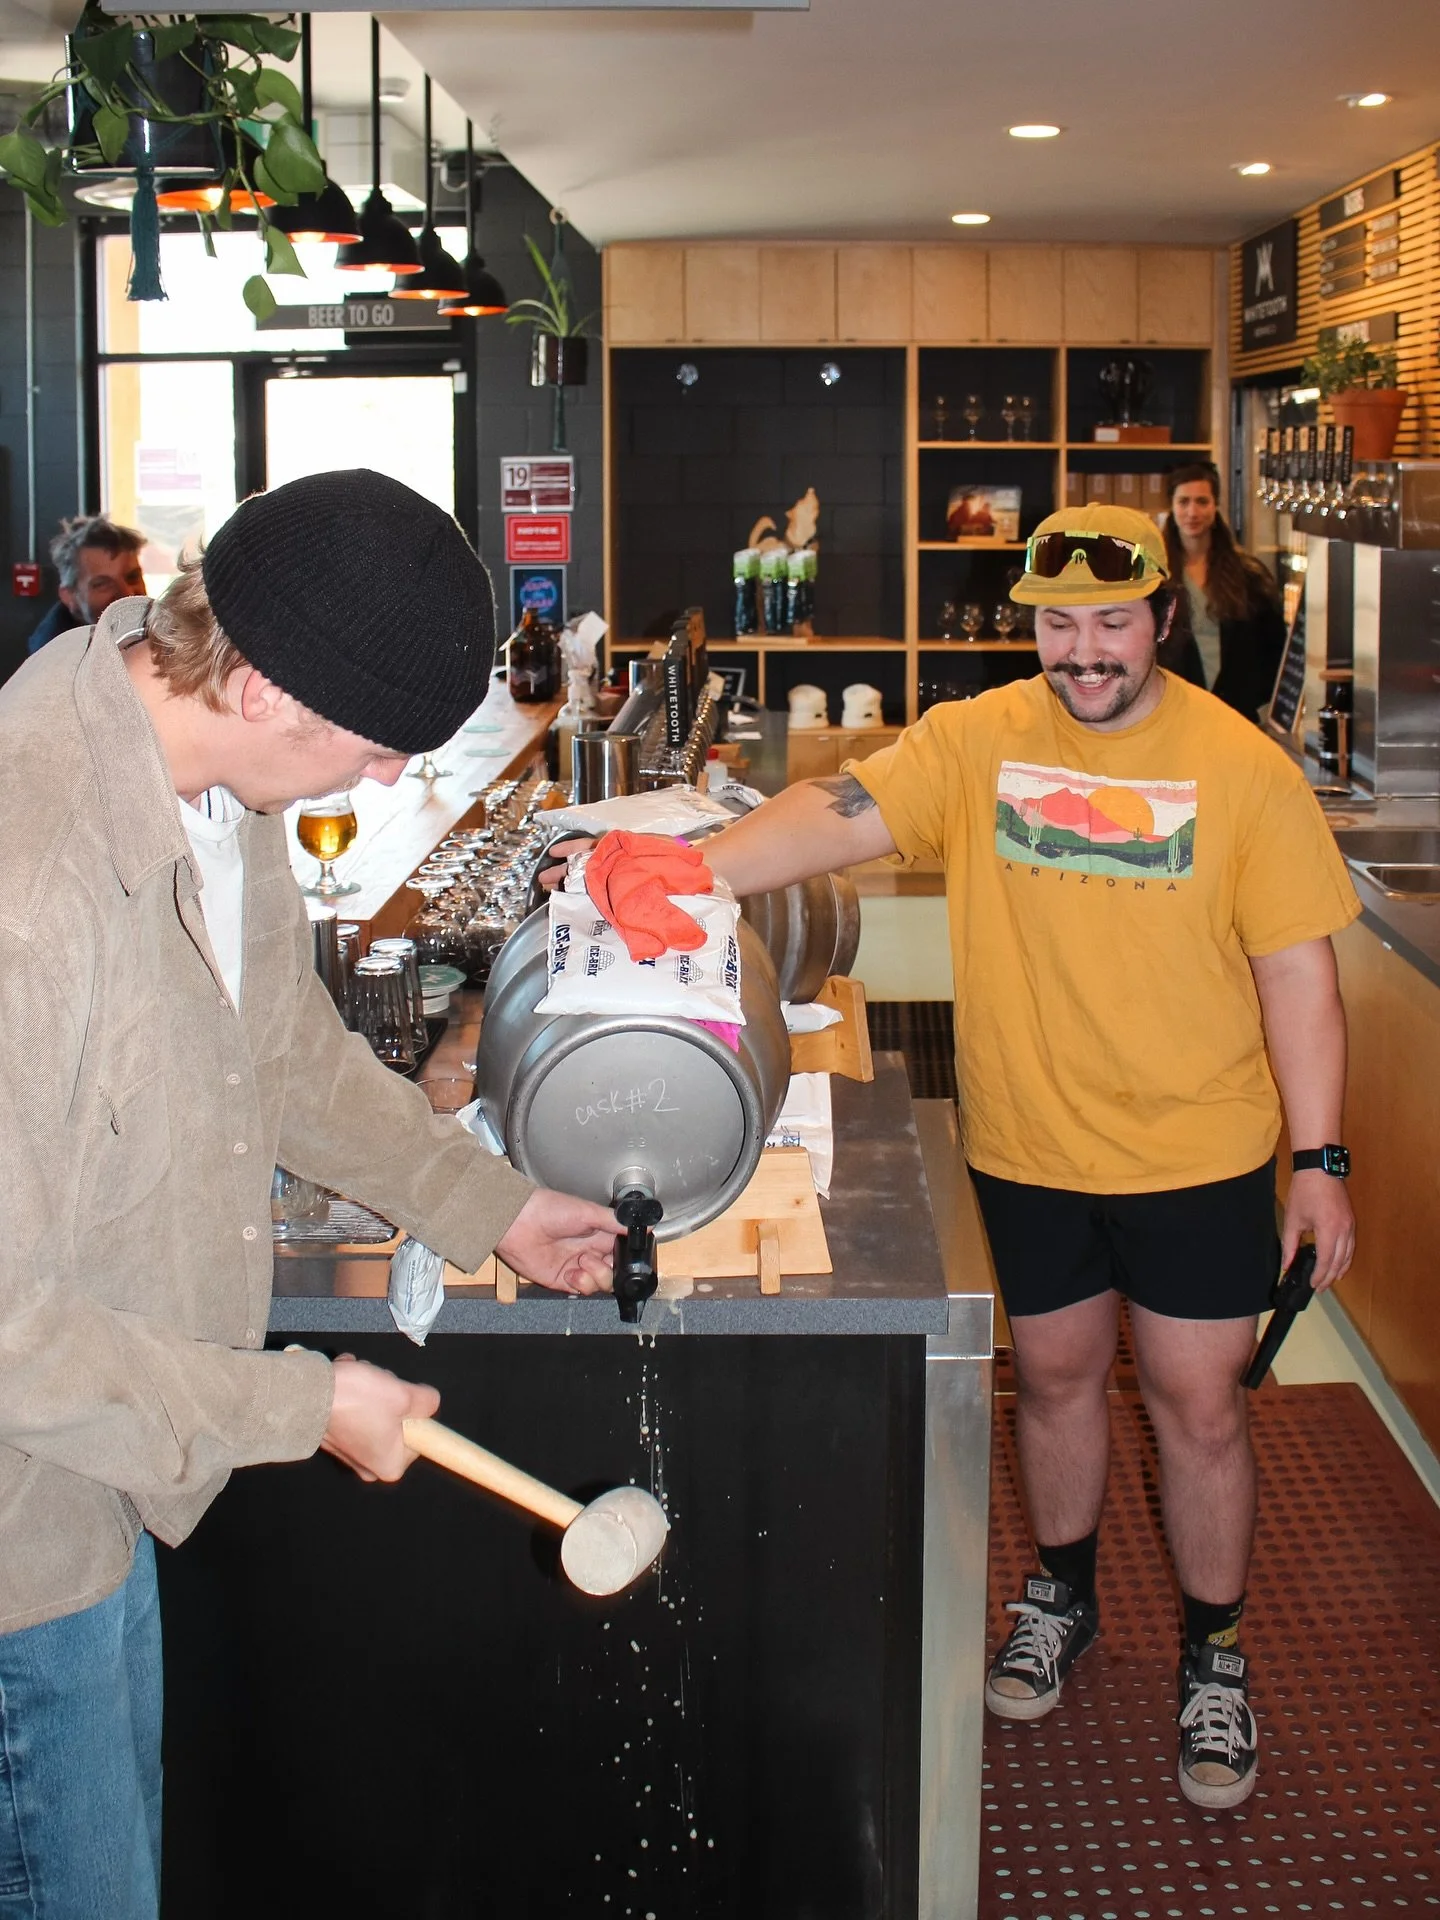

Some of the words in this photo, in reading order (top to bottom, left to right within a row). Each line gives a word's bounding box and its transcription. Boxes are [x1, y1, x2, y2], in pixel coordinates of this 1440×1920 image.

[308, 306, 344, 327] BEER
[350, 305, 368, 326] TO
[372, 304, 394, 326] GO
[507, 467, 527, 487] 19
[668, 665, 680, 742] WHITETOOTH
[1005, 862, 1177, 892] ARIZONA
[587, 945, 600, 976] ICE-BRIX
